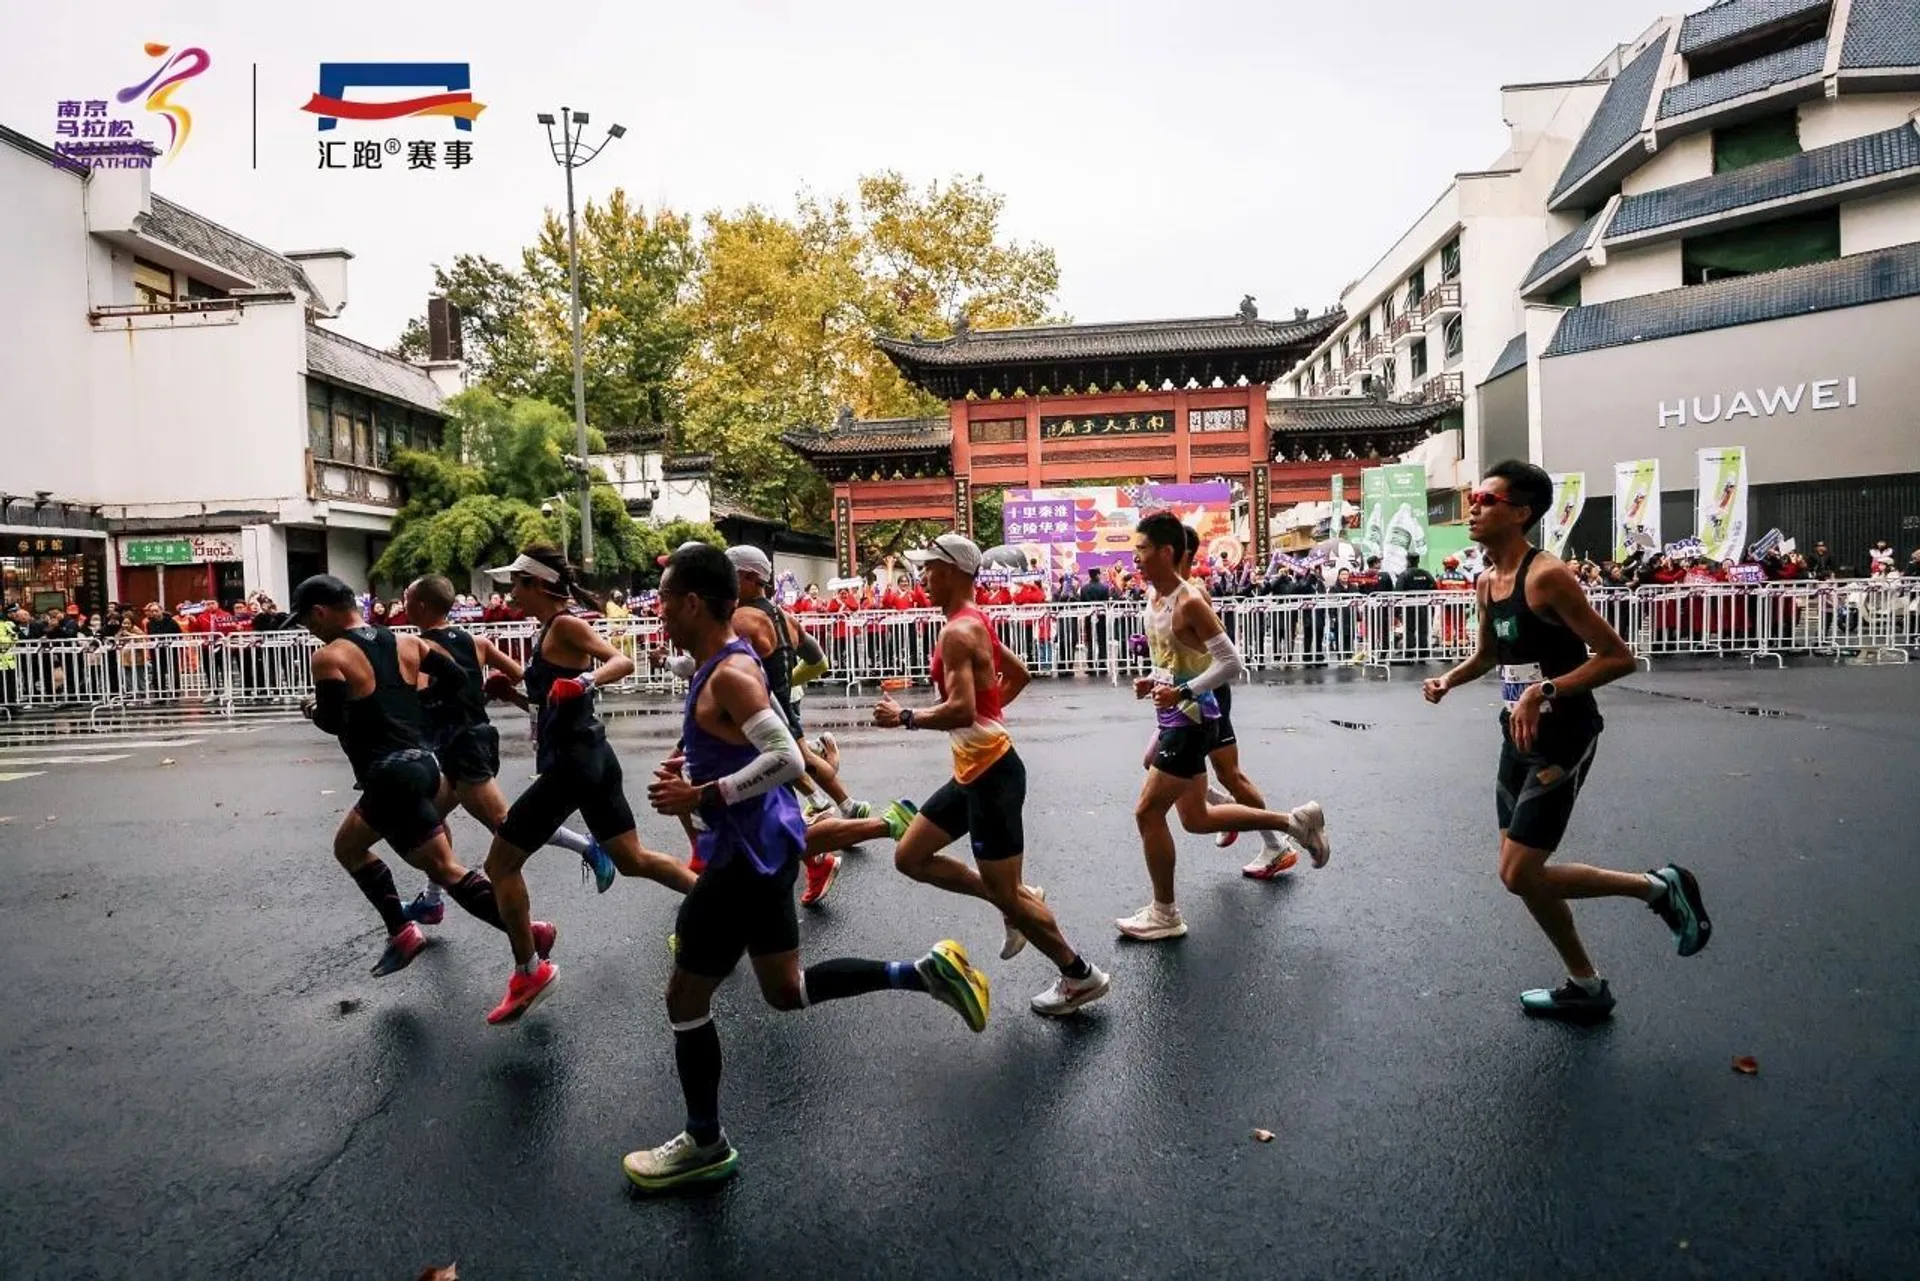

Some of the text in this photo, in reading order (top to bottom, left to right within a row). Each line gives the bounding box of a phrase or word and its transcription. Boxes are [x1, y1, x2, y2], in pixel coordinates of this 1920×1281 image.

[1658, 376, 1858, 428] HUAWEI
[1007, 505, 1069, 519] 十里秦淮
[1008, 521, 1069, 535] 金陵华章
